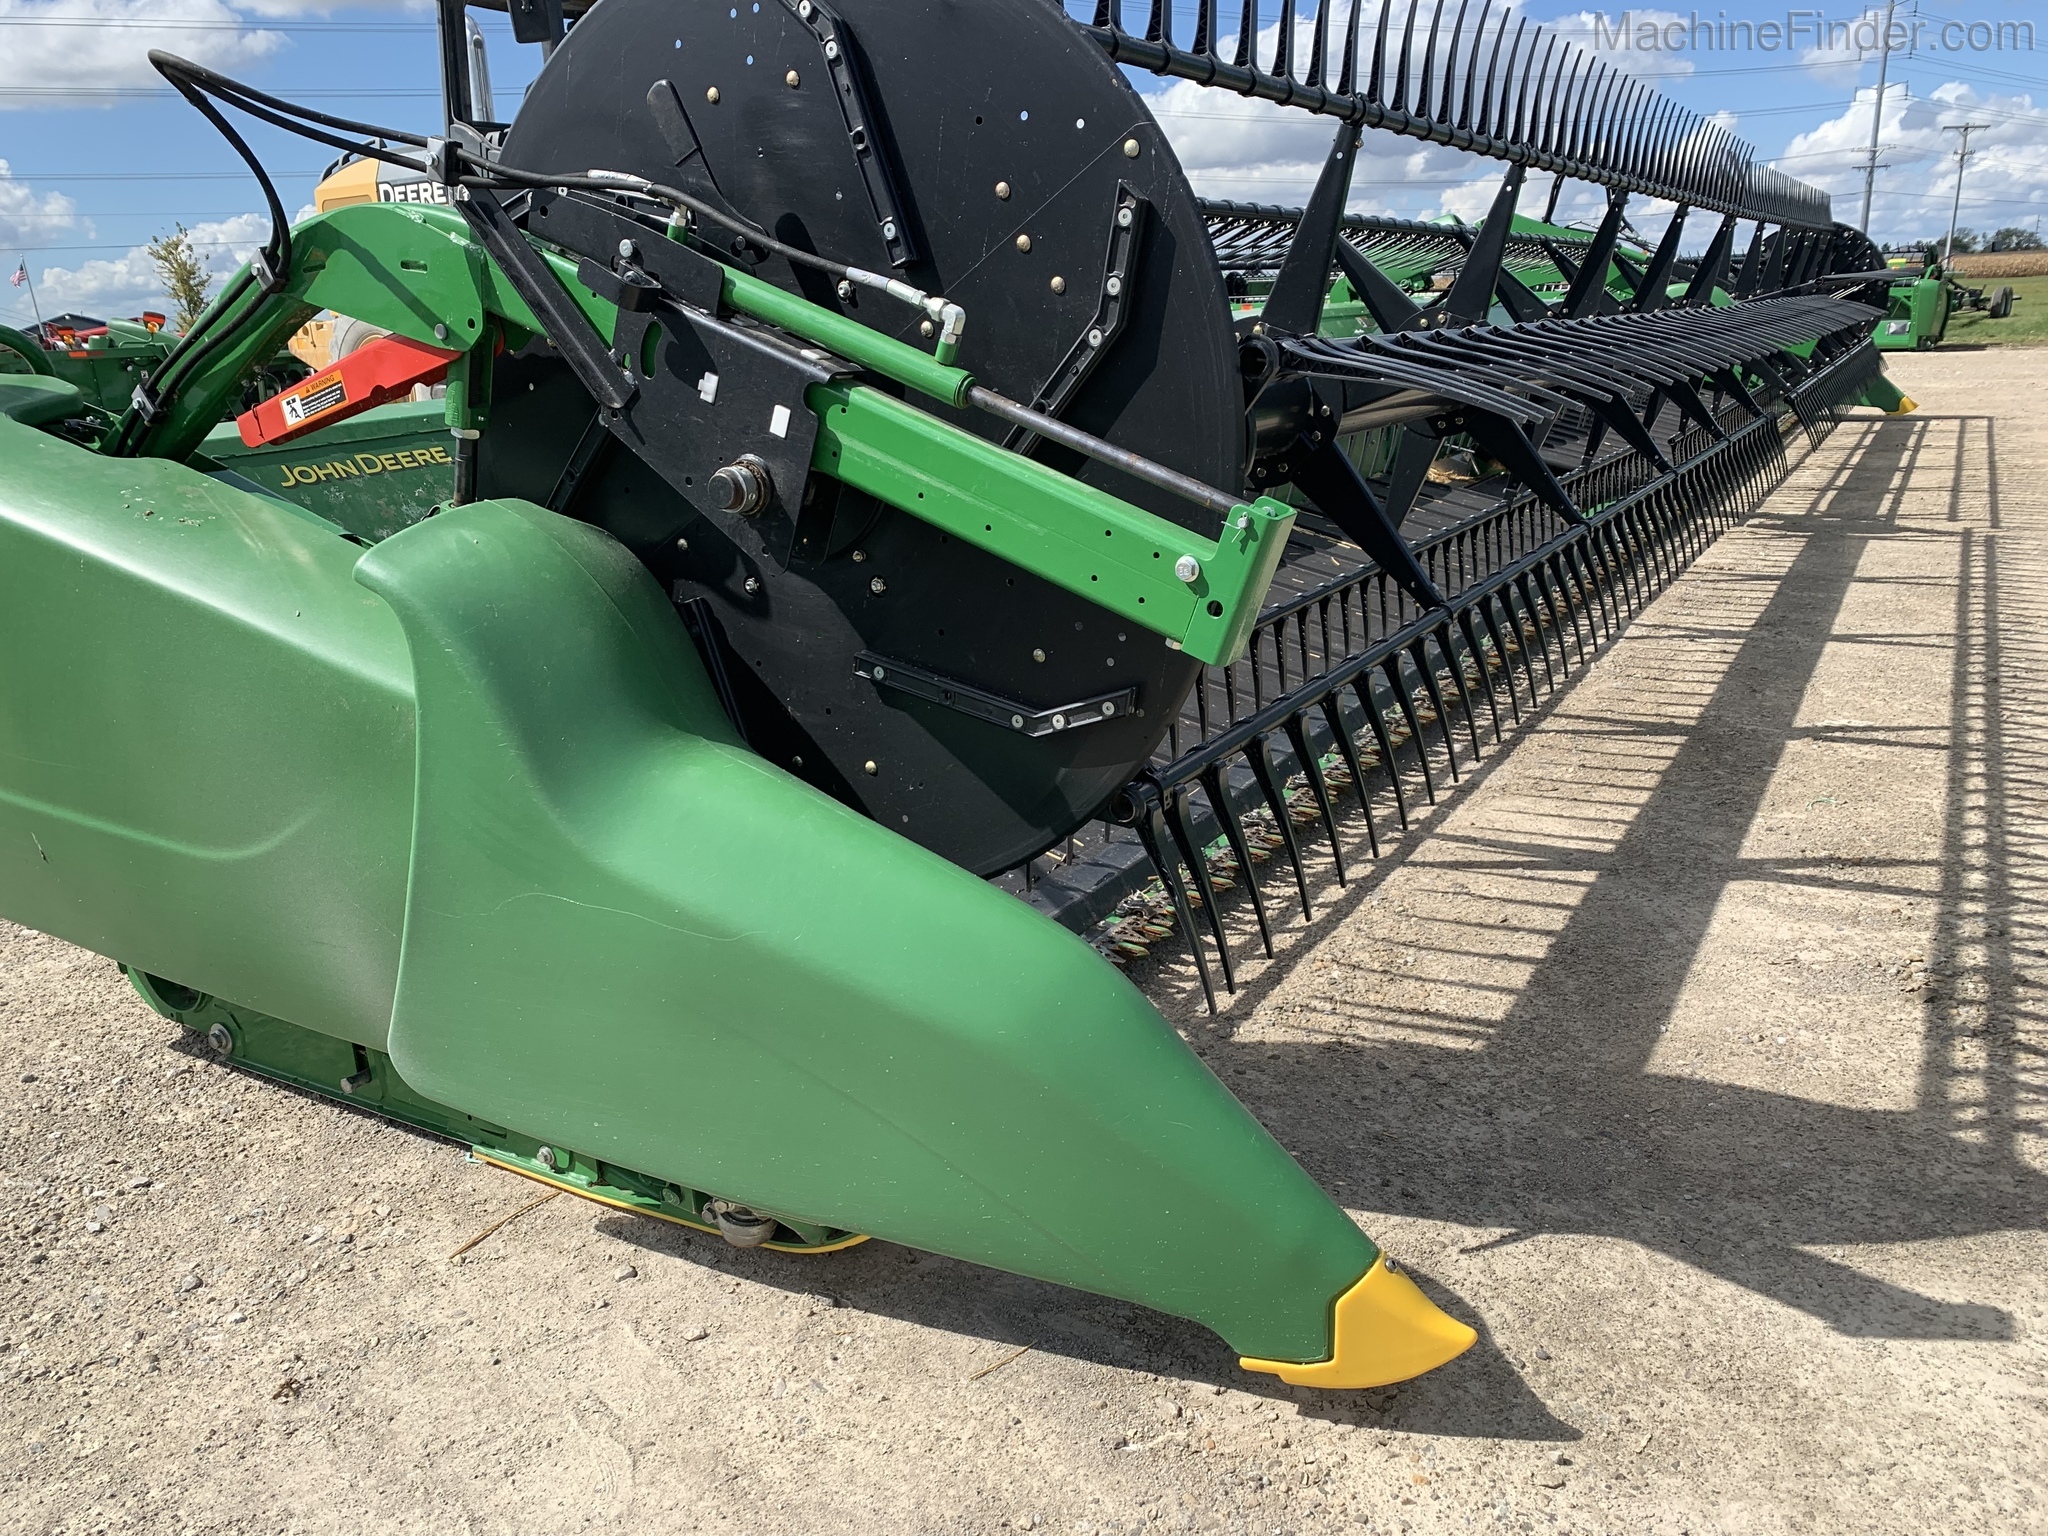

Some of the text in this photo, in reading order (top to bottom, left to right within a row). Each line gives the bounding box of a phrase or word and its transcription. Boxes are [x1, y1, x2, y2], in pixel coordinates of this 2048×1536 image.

[378, 181, 447, 204] DEERE
[310, 374, 335, 391] WARNING
[281, 446, 452, 487] JOHN DEERE
